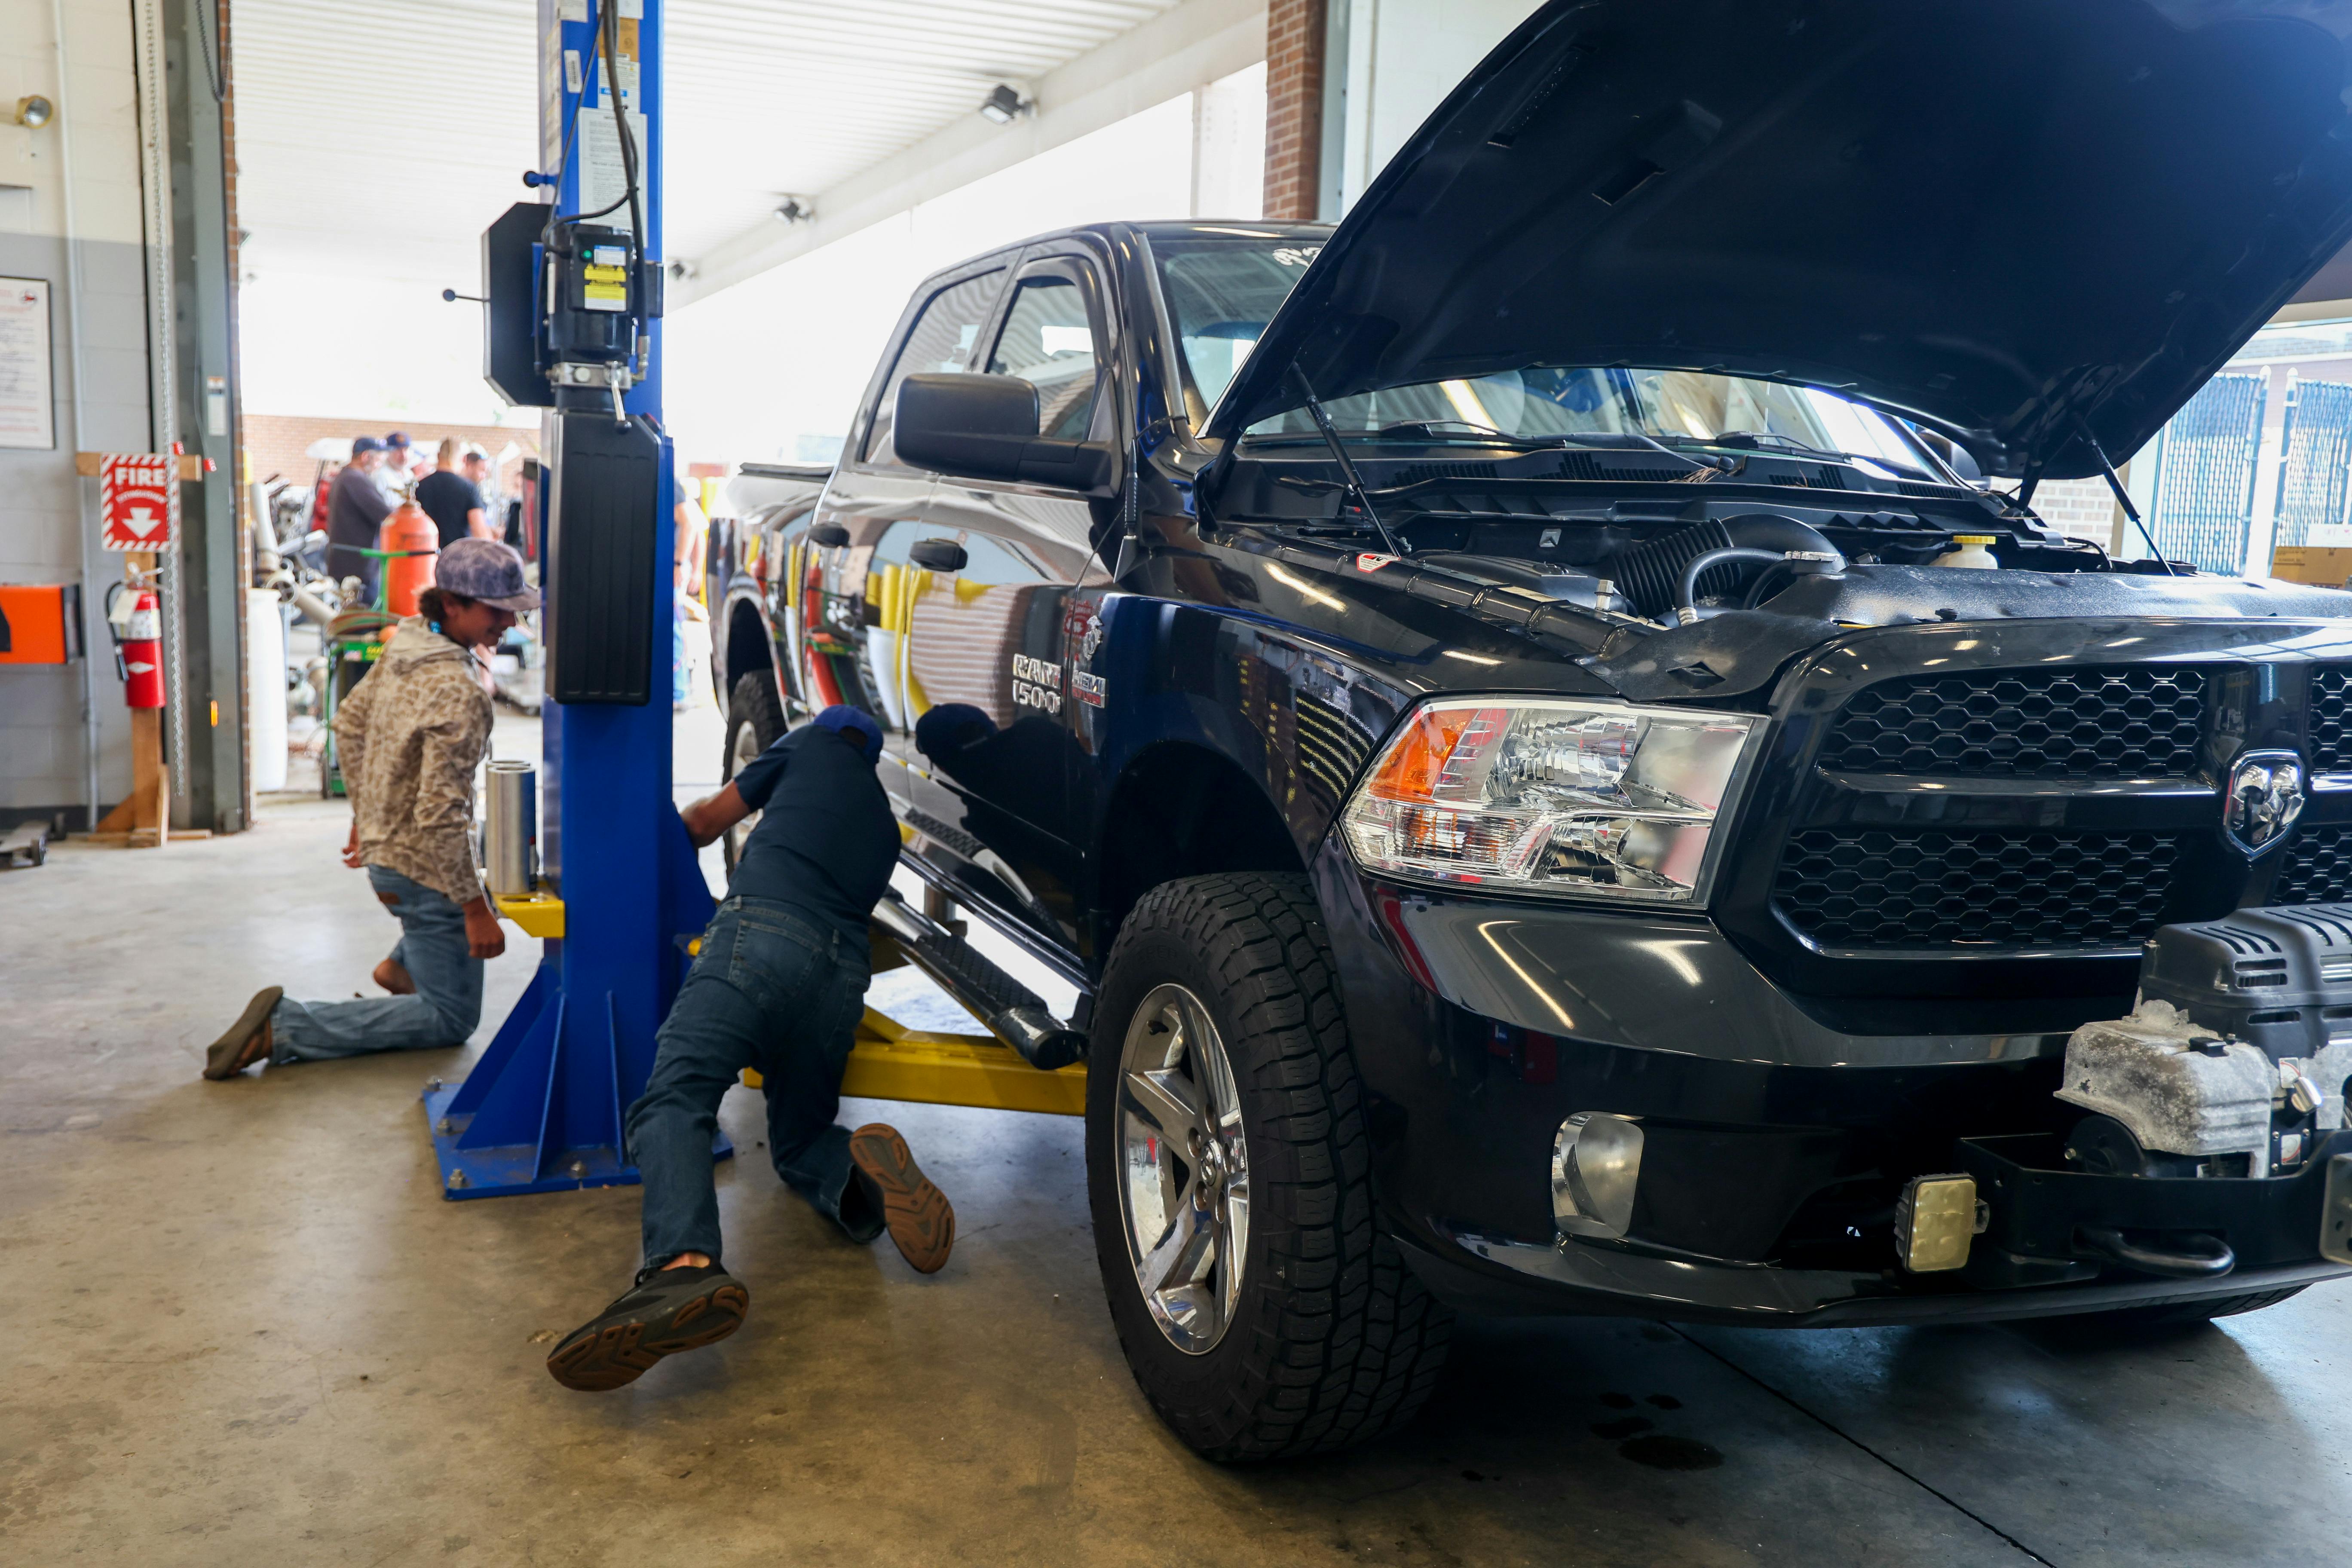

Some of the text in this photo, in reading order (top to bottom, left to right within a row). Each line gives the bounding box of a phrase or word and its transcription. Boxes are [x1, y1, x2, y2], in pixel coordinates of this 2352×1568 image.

[115, 467, 167, 487] FIRE
[1013, 653, 1061, 689] RAM
[1072, 670, 1106, 695] HEMI
[1013, 679, 1061, 715] 1500
